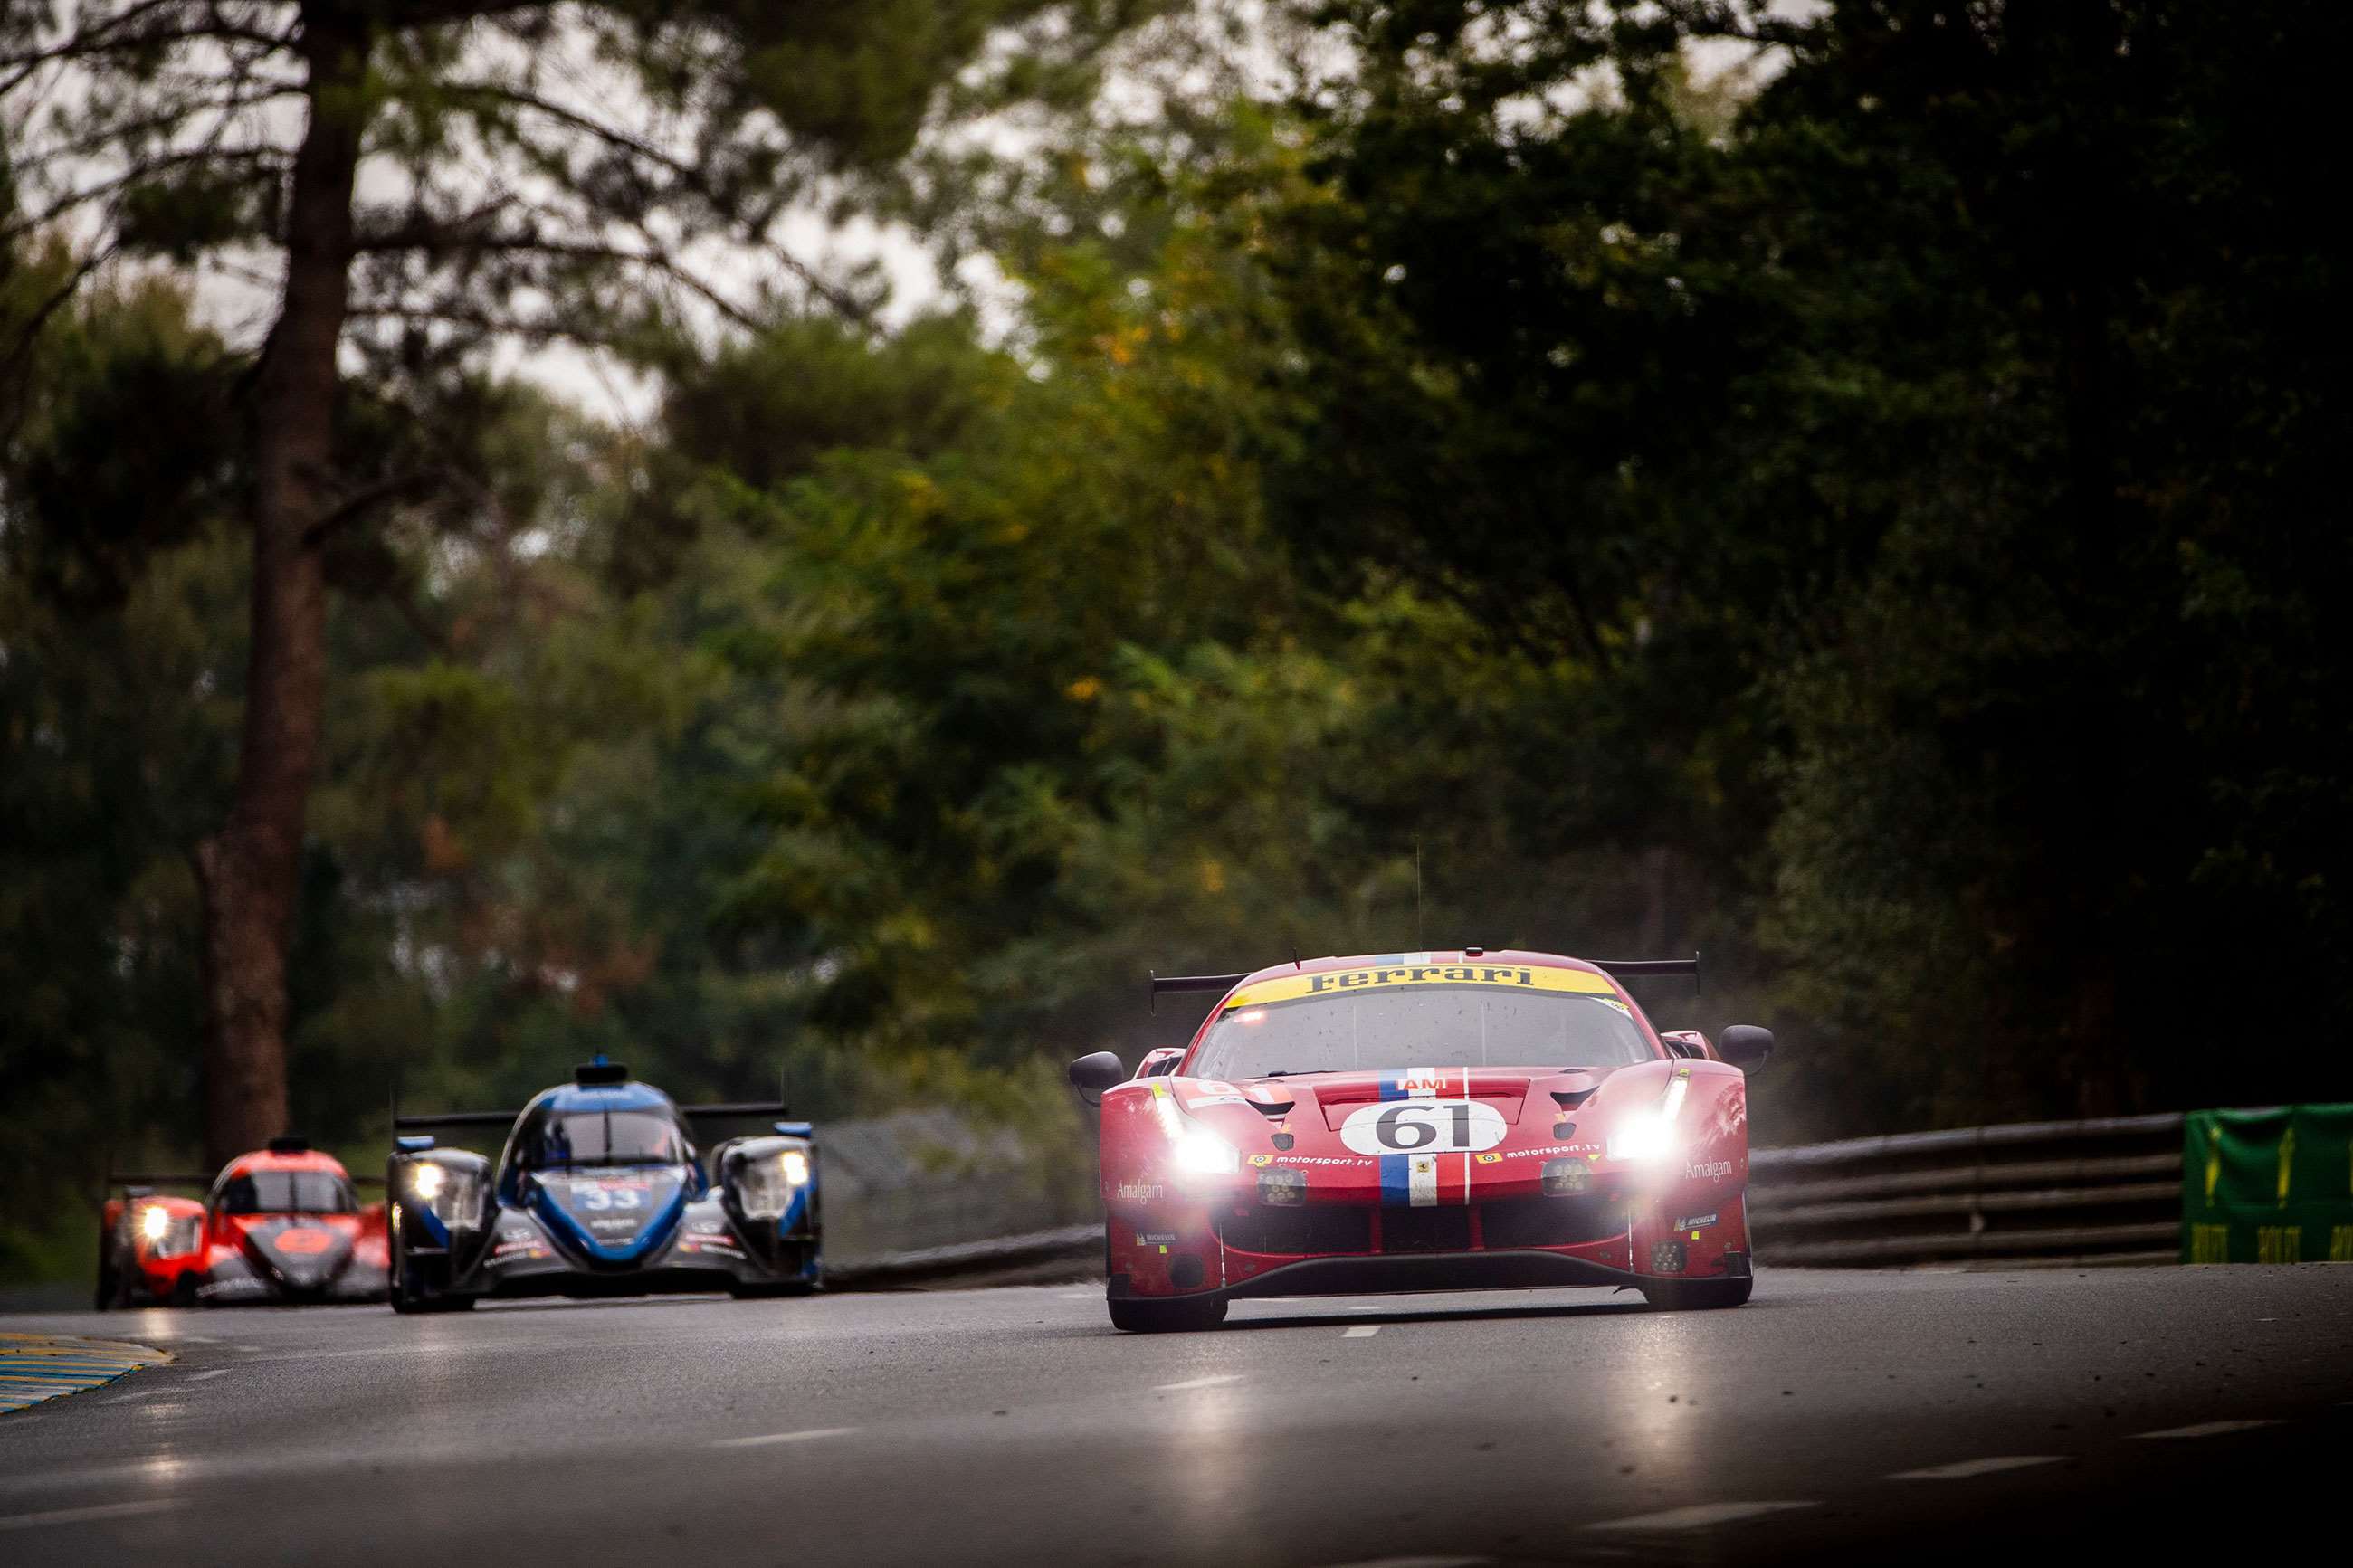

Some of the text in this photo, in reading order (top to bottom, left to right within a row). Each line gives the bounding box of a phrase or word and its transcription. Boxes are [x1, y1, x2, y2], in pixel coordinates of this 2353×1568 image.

[1305, 965, 1535, 993] Ferrari
[1404, 1079, 1443, 1089] AM
[1376, 1104, 1470, 1149] 61
[1275, 1155, 1374, 1167] motorsport.tv
[1506, 1143, 1601, 1159] motorsport.tv
[1685, 1156, 1732, 1183] Amalgam
[584, 1190, 639, 1210] 33
[1117, 1178, 1163, 1205] Amalgam
